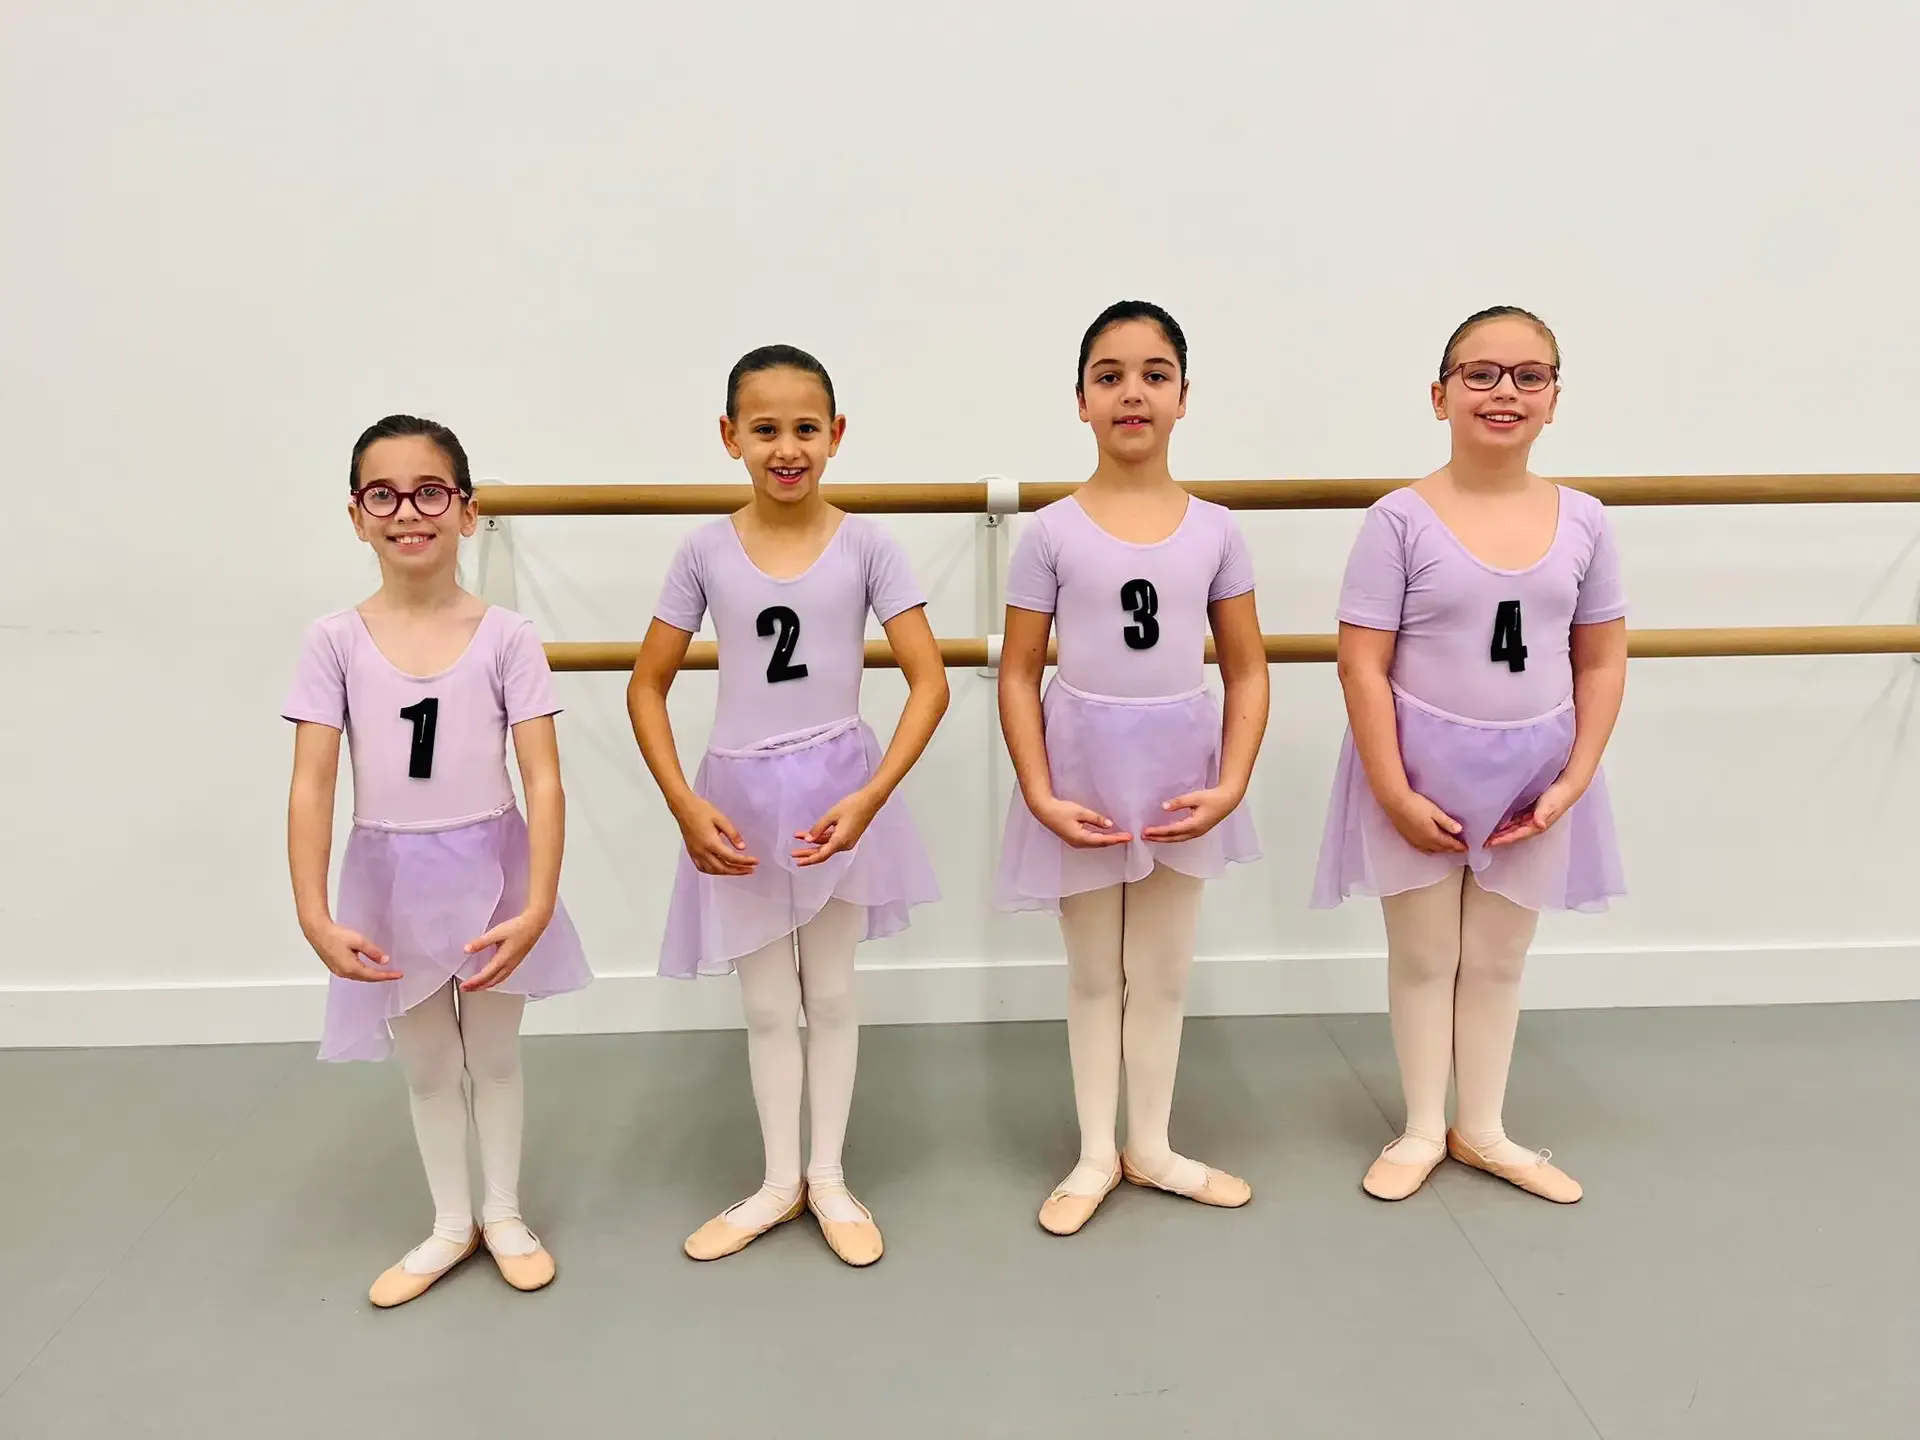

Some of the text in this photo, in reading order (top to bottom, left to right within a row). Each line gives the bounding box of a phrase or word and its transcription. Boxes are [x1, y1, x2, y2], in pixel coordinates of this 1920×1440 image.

[756, 606, 808, 683] 2
[1121, 579, 1159, 650] 3
[1490, 600, 1528, 672] 4
[400, 697, 438, 778] 1
